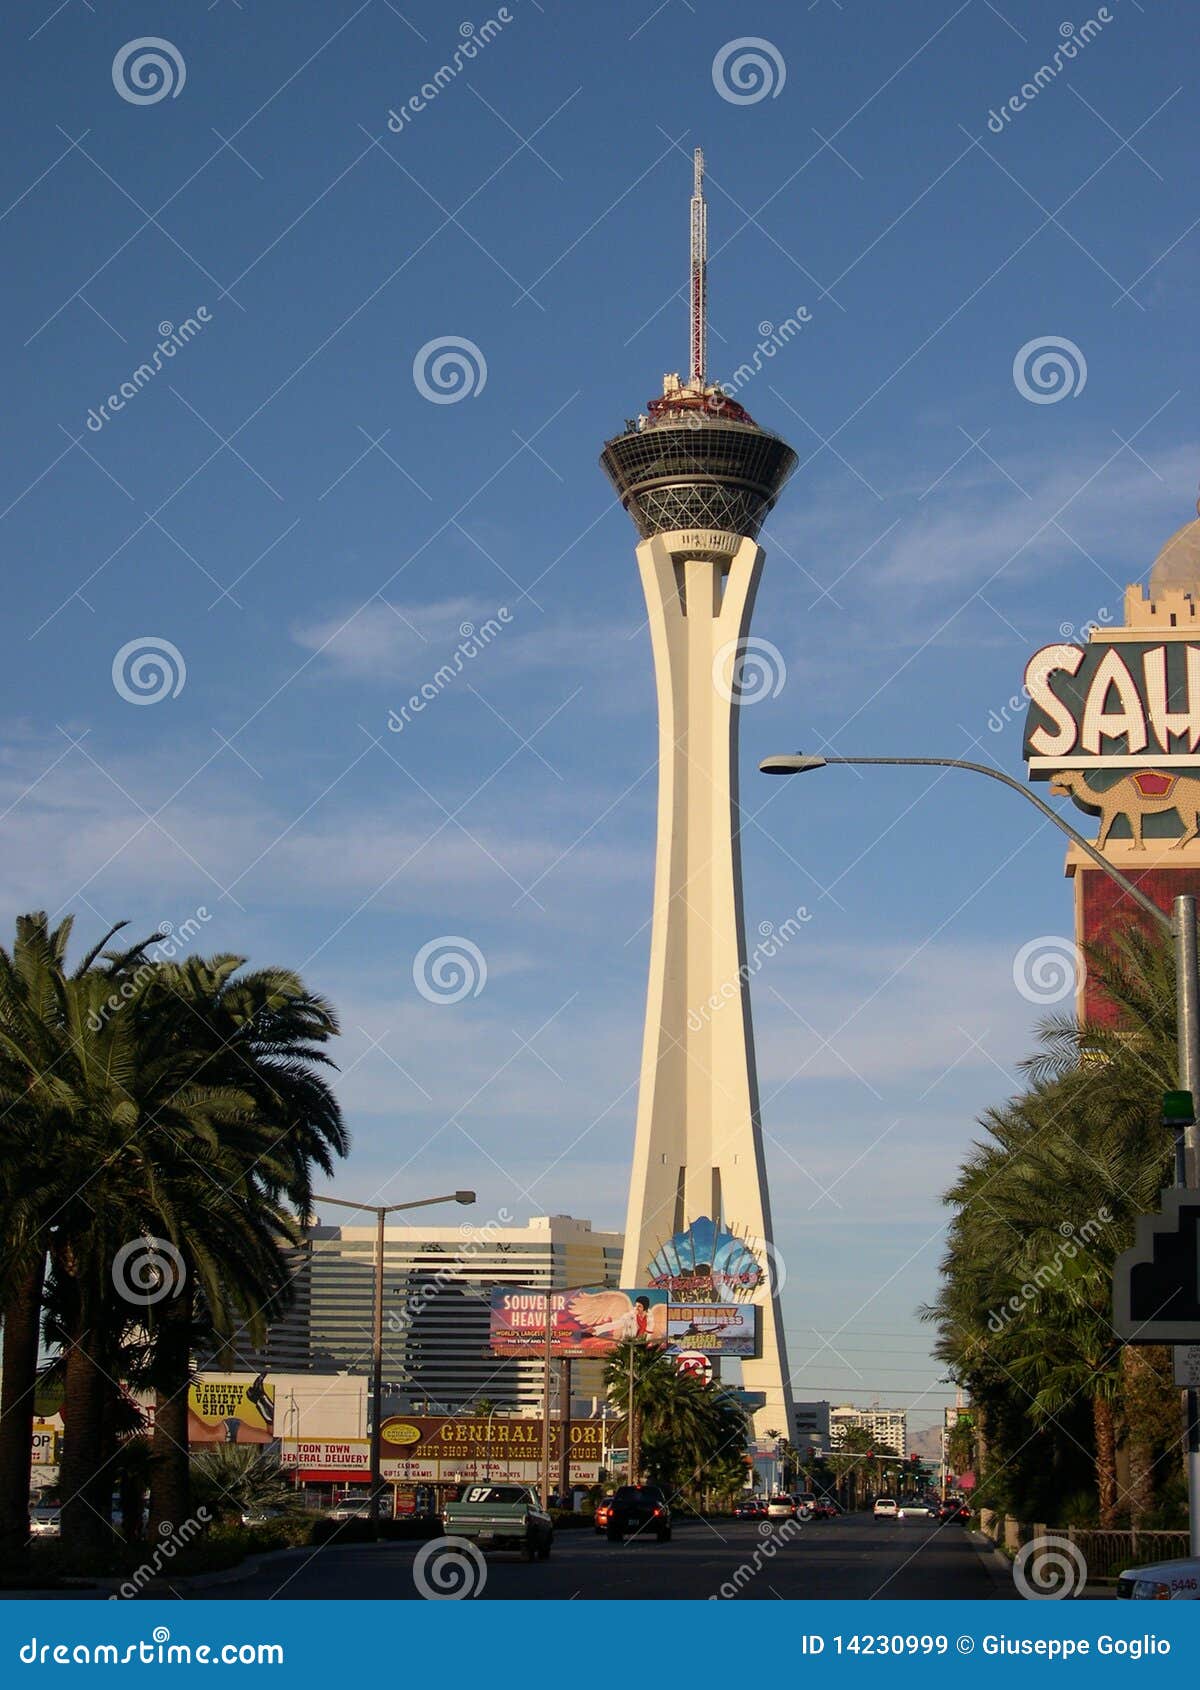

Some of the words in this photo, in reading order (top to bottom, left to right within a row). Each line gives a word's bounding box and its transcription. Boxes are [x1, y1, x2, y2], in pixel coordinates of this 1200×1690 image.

[204, 1385, 244, 1393] COUNTRY
[196, 1394, 243, 1405] VARIETY
[203, 1404, 236, 1416] SHOW
[440, 1424, 538, 1442] GENERAL
[549, 1425, 609, 1443] SORE
[298, 1444, 321, 1453] TOON
[325, 1444, 350, 1453] TOWN
[416, 1445, 439, 1457] GIFT
[442, 1445, 468, 1457] SHOP
[282, 1453, 321, 1463] GENERAL
[326, 1454, 368, 1463] DELIVERY
[469, 1487, 493, 1502] 97
[1171, 1578, 1197, 1591] 5446
